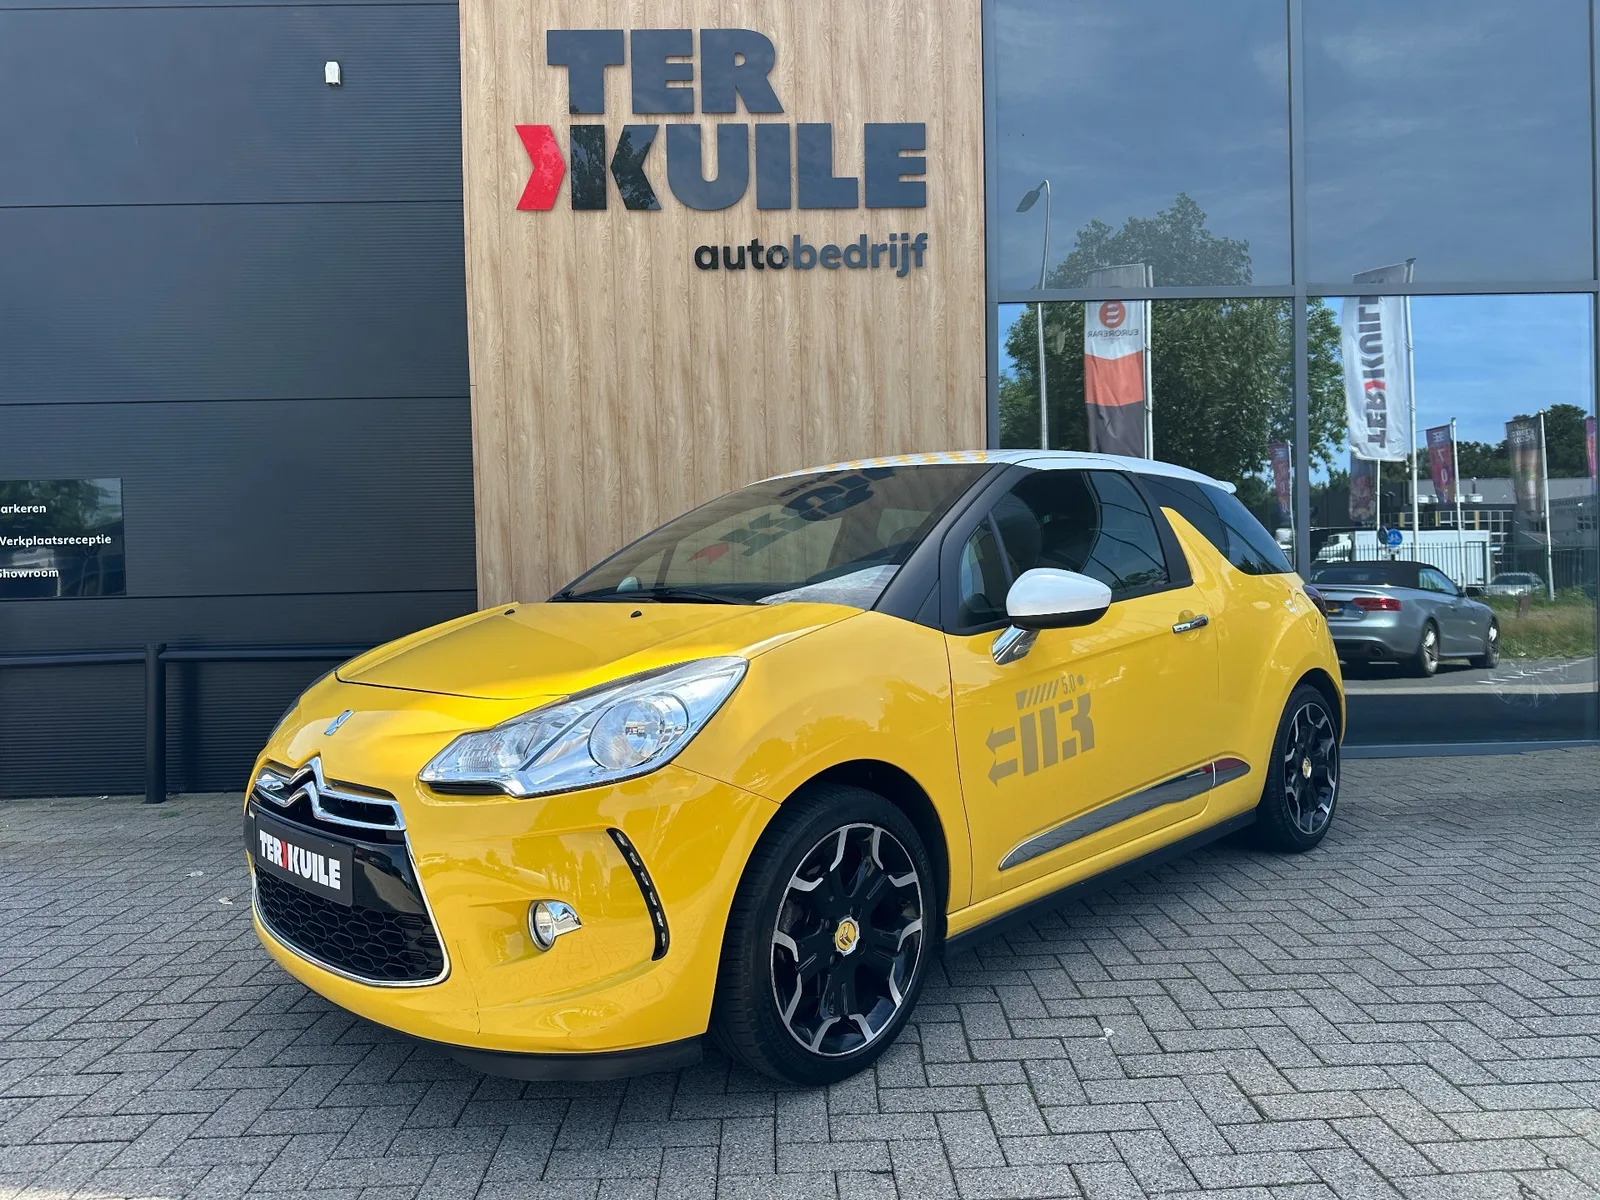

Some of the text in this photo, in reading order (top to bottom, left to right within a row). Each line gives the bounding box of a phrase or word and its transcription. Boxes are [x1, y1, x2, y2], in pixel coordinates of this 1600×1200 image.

[546, 28, 784, 115] TER
[569, 123, 927, 211] KUILE
[694, 232, 929, 277] autobedrijf
[0, 504, 47, 514] arkeren
[259, 829, 341, 891] TER KUILE
